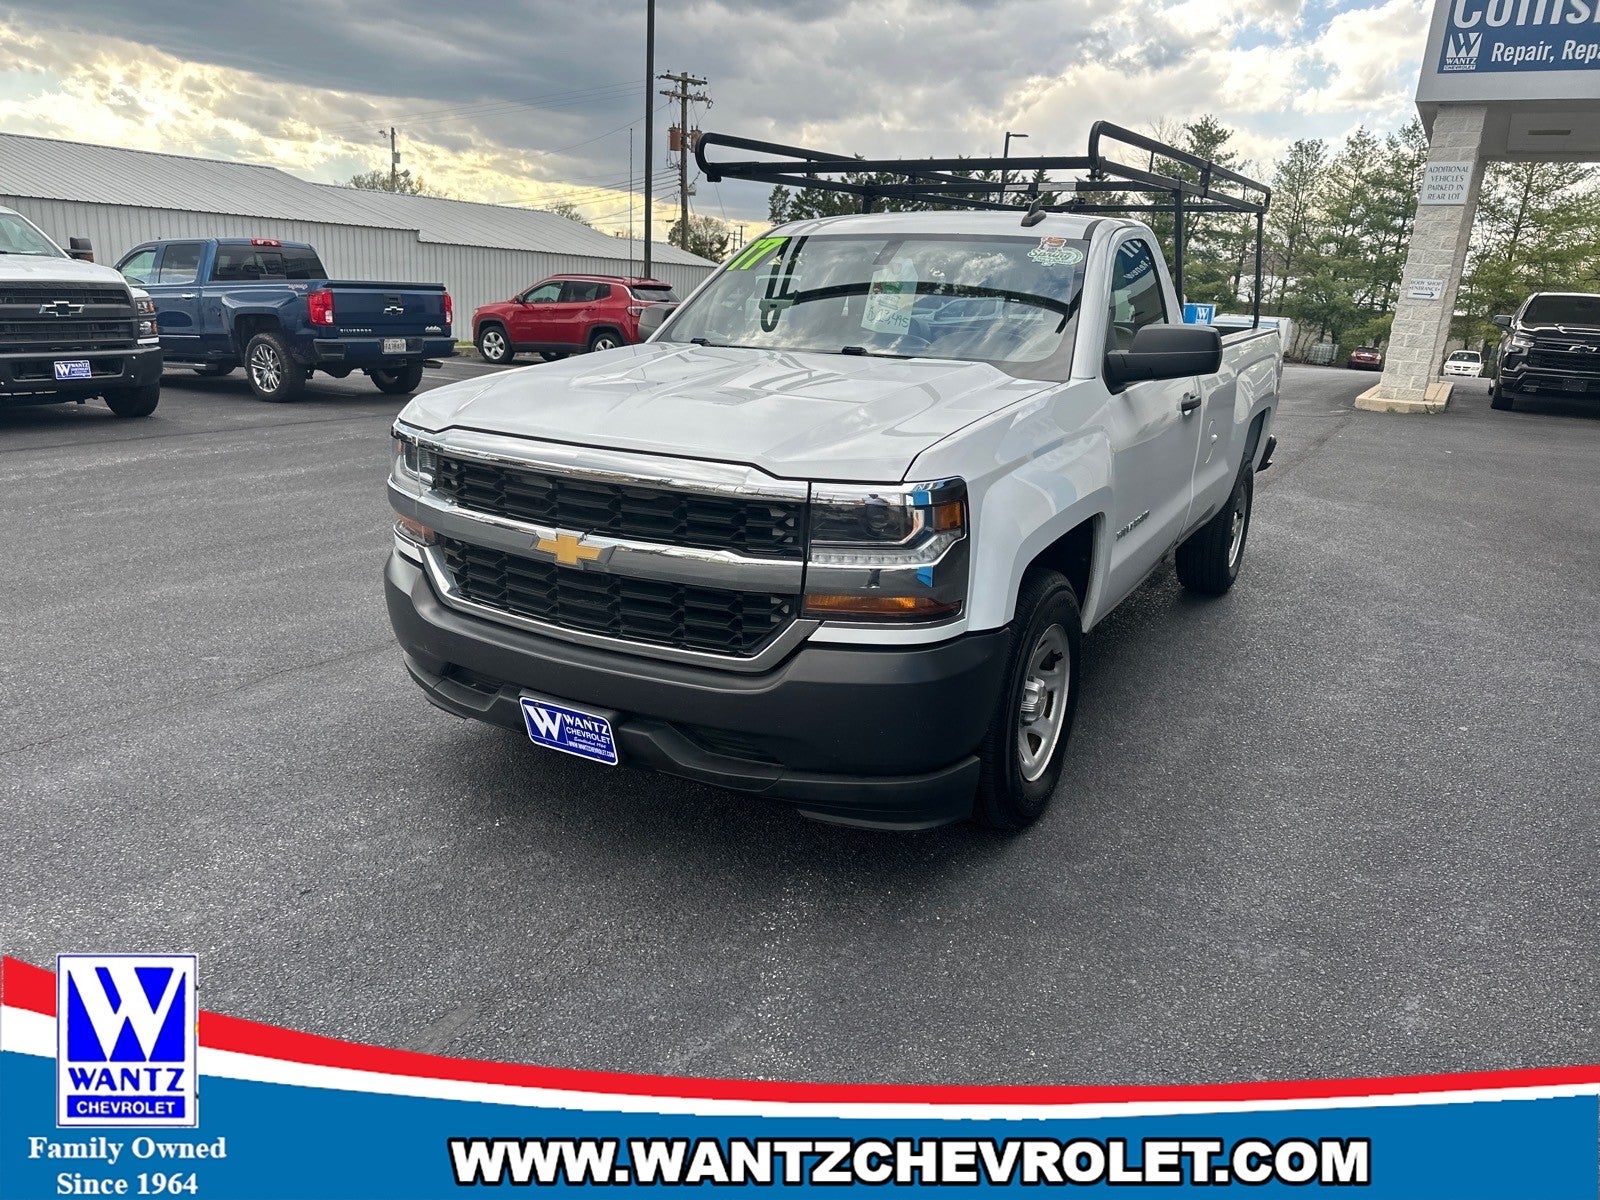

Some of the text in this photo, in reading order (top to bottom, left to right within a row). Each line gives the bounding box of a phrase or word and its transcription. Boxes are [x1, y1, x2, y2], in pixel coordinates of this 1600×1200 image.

[1446, 57, 1477, 65] WANTZ
[1491, 40, 1555, 65] Repair,
[1428, 165, 1470, 173] ADDITIONAL
[523, 704, 563, 741] W
[562, 713, 610, 736] WANTZ
[566, 726, 610, 744] CHEVROLET
